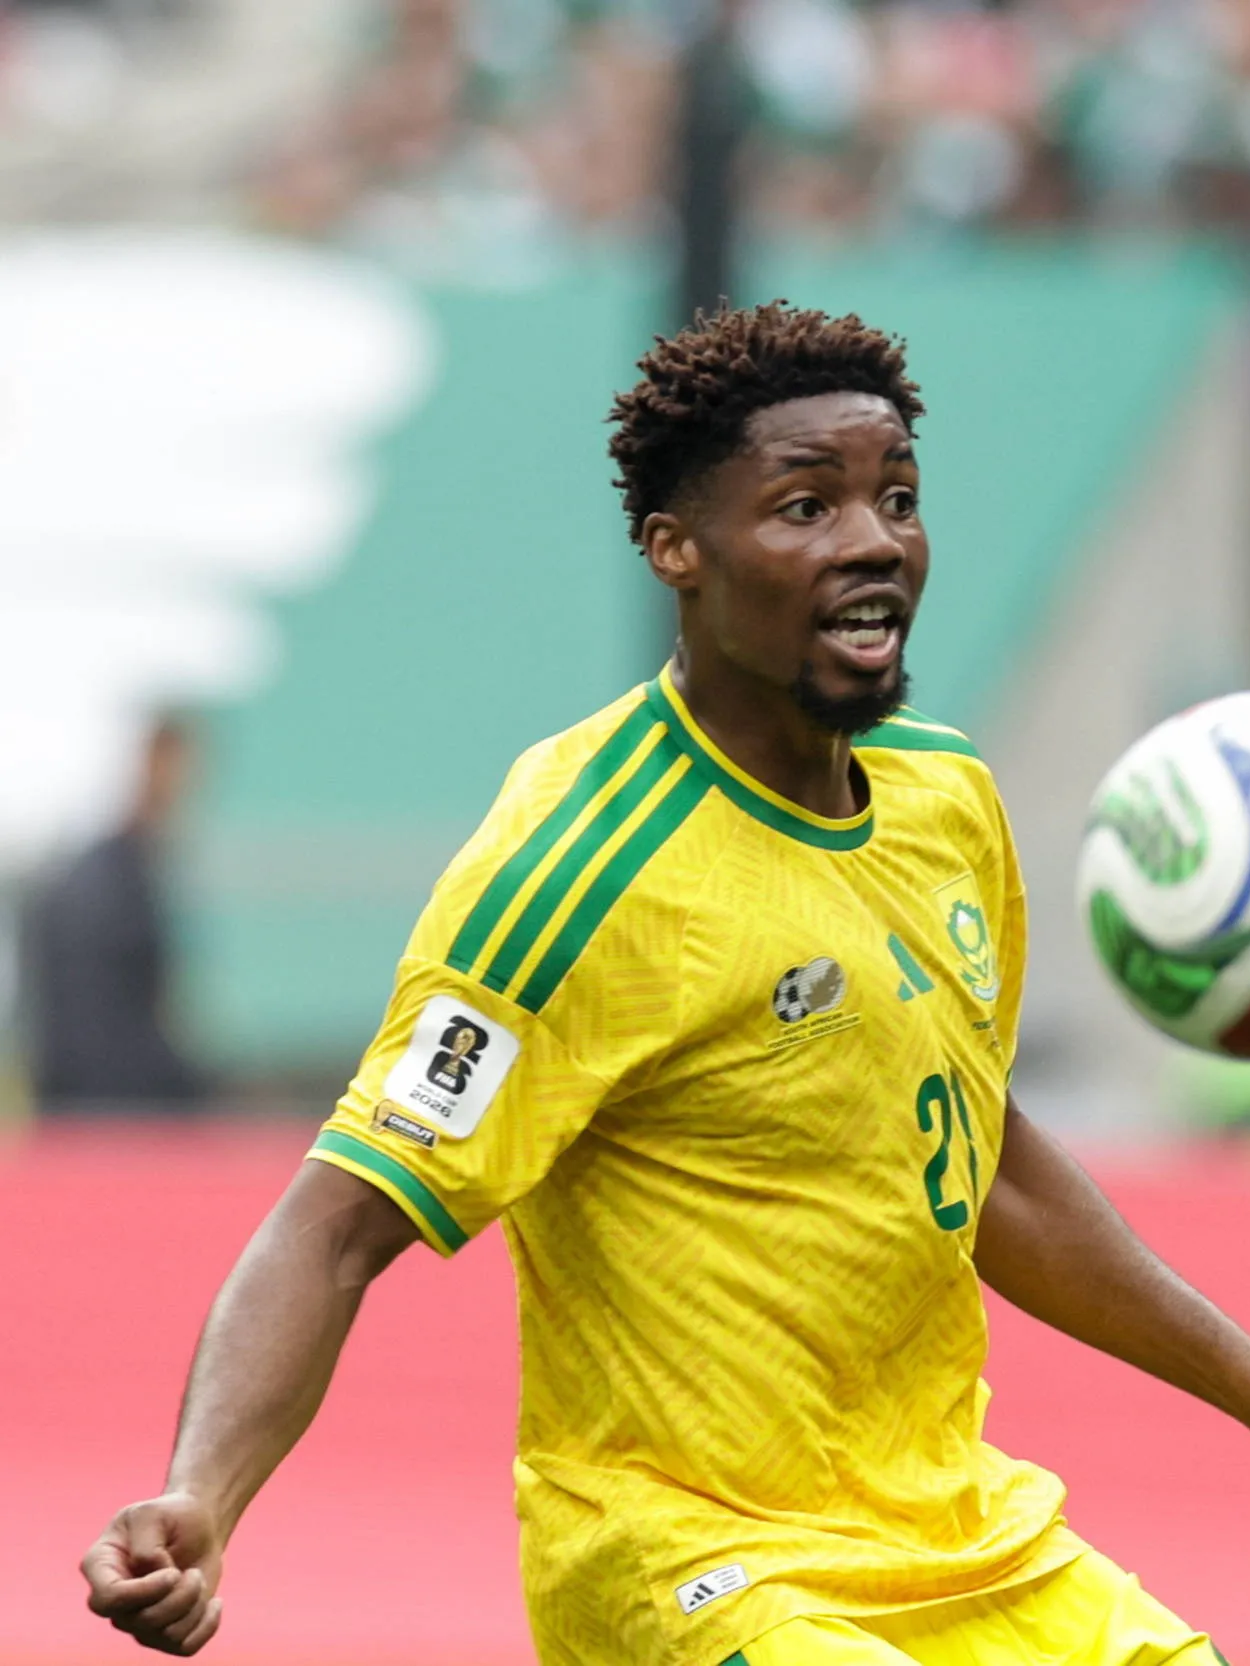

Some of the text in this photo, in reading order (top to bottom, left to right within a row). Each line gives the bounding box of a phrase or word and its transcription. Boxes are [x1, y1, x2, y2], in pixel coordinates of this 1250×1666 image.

[434, 1071, 457, 1088] FIFA
[409, 1089, 453, 1118] 2026
[387, 1114, 435, 1139] DEBUT
